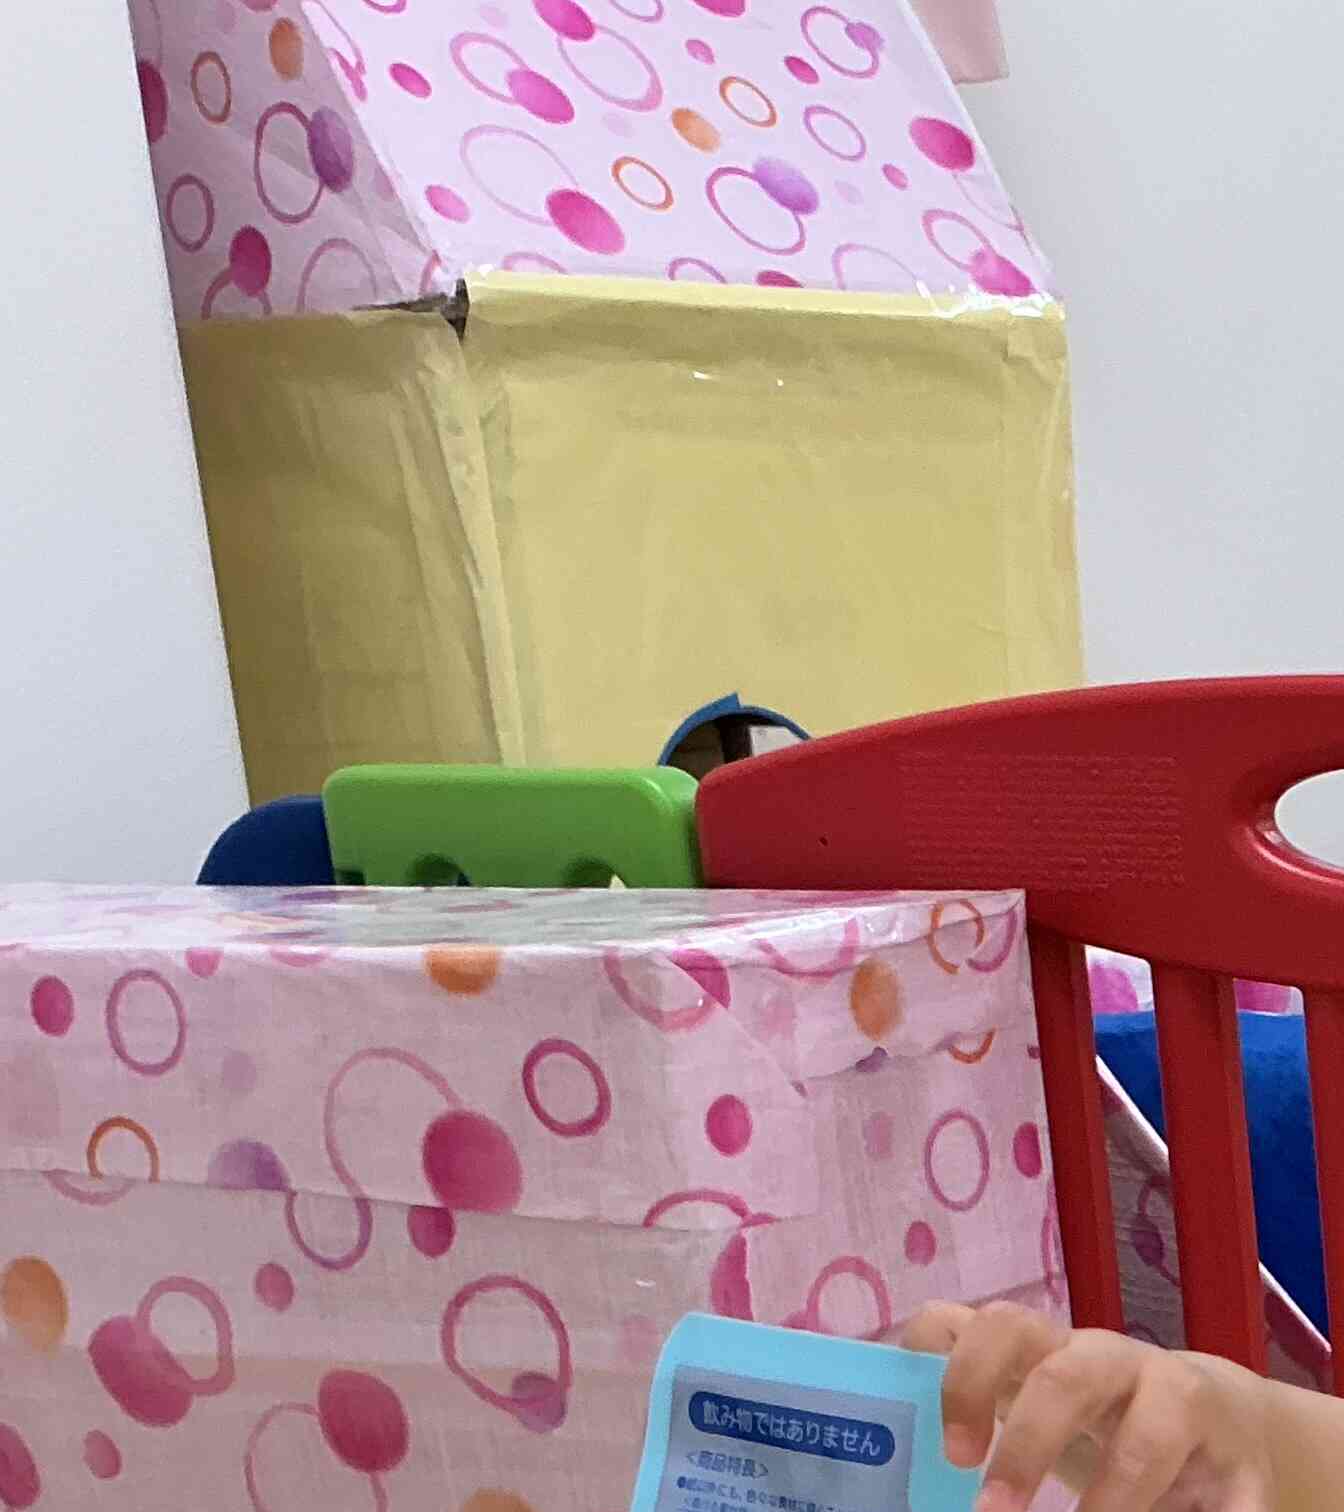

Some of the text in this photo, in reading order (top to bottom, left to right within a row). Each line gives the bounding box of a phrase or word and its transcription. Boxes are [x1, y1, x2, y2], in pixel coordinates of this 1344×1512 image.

[702, 1400, 881, 1457] 飲み物ではありません
